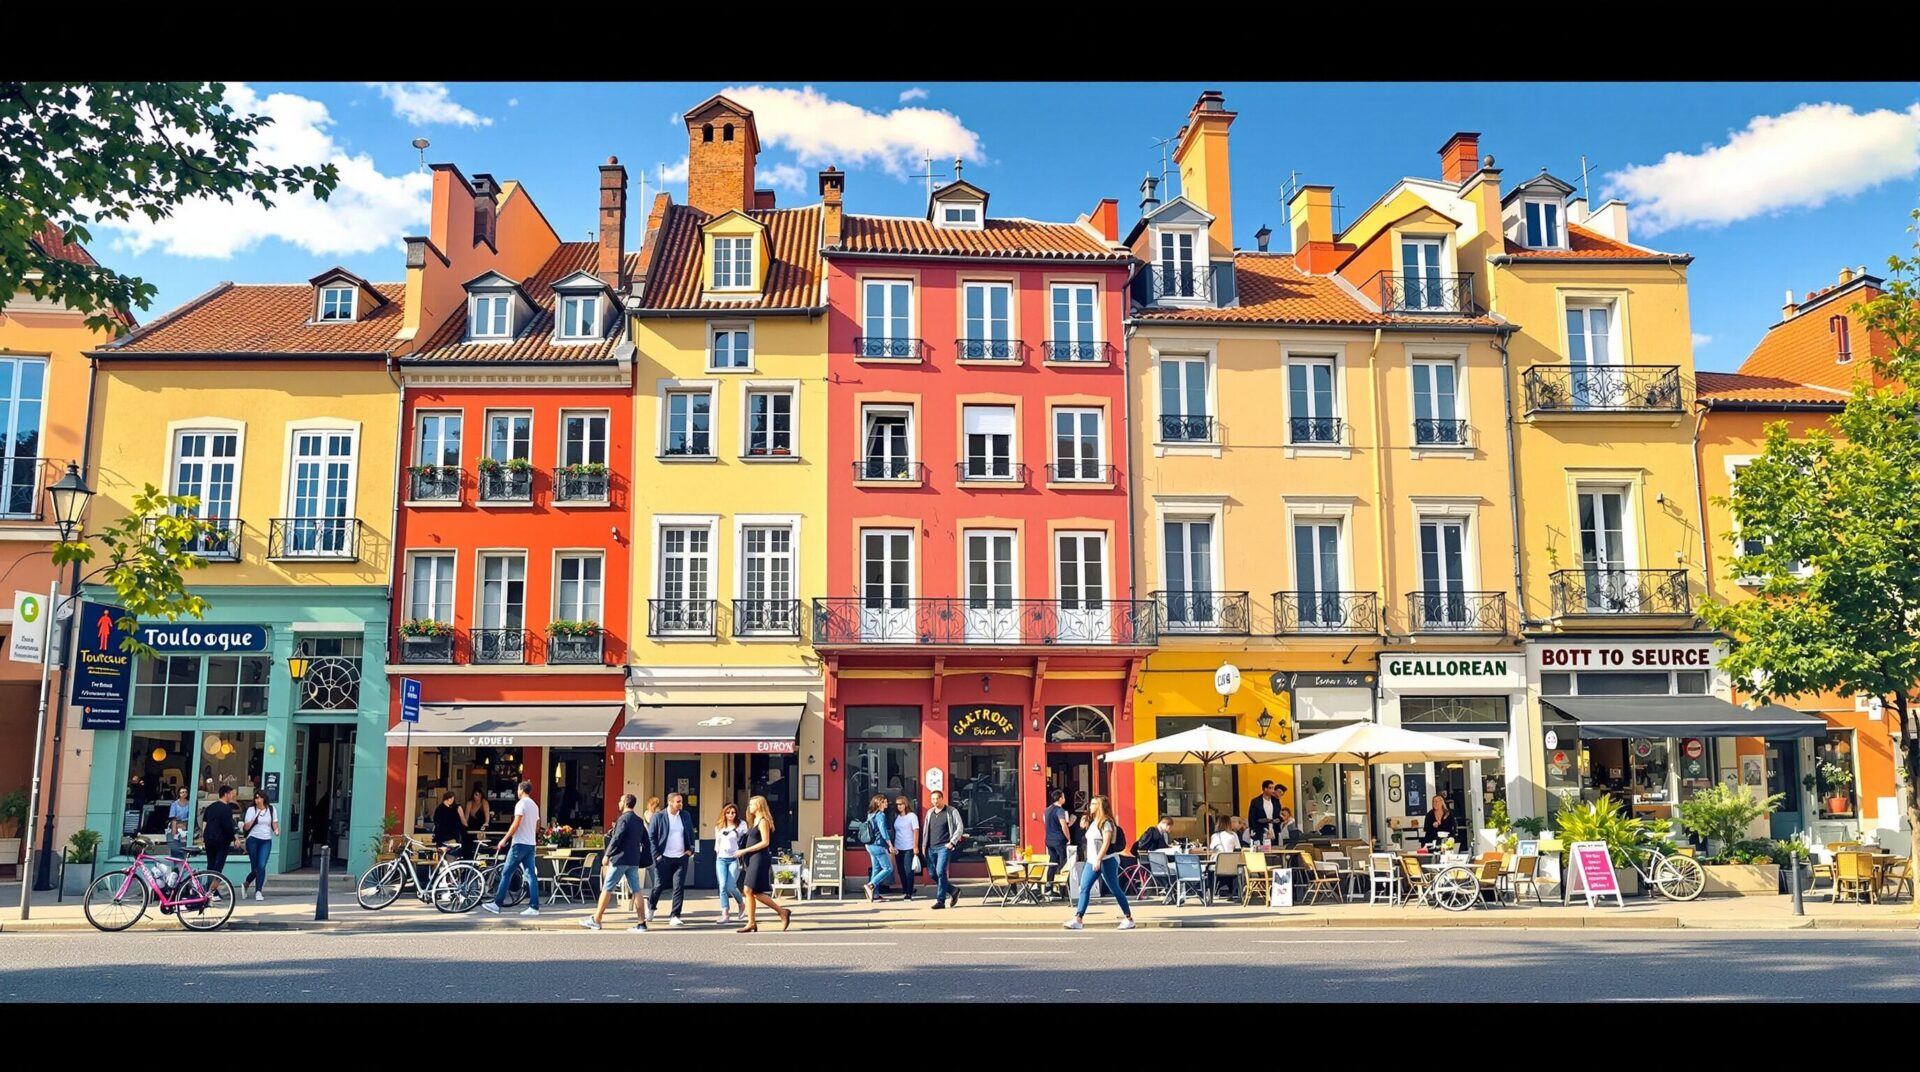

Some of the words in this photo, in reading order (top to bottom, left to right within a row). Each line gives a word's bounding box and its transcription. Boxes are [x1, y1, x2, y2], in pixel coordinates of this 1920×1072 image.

[1542, 649, 1592, 666] BOTT
[1599, 649, 1624, 666] TO
[1632, 648, 1710, 666] SEURCE
[1389, 660, 1507, 676] GEALLOREAN
